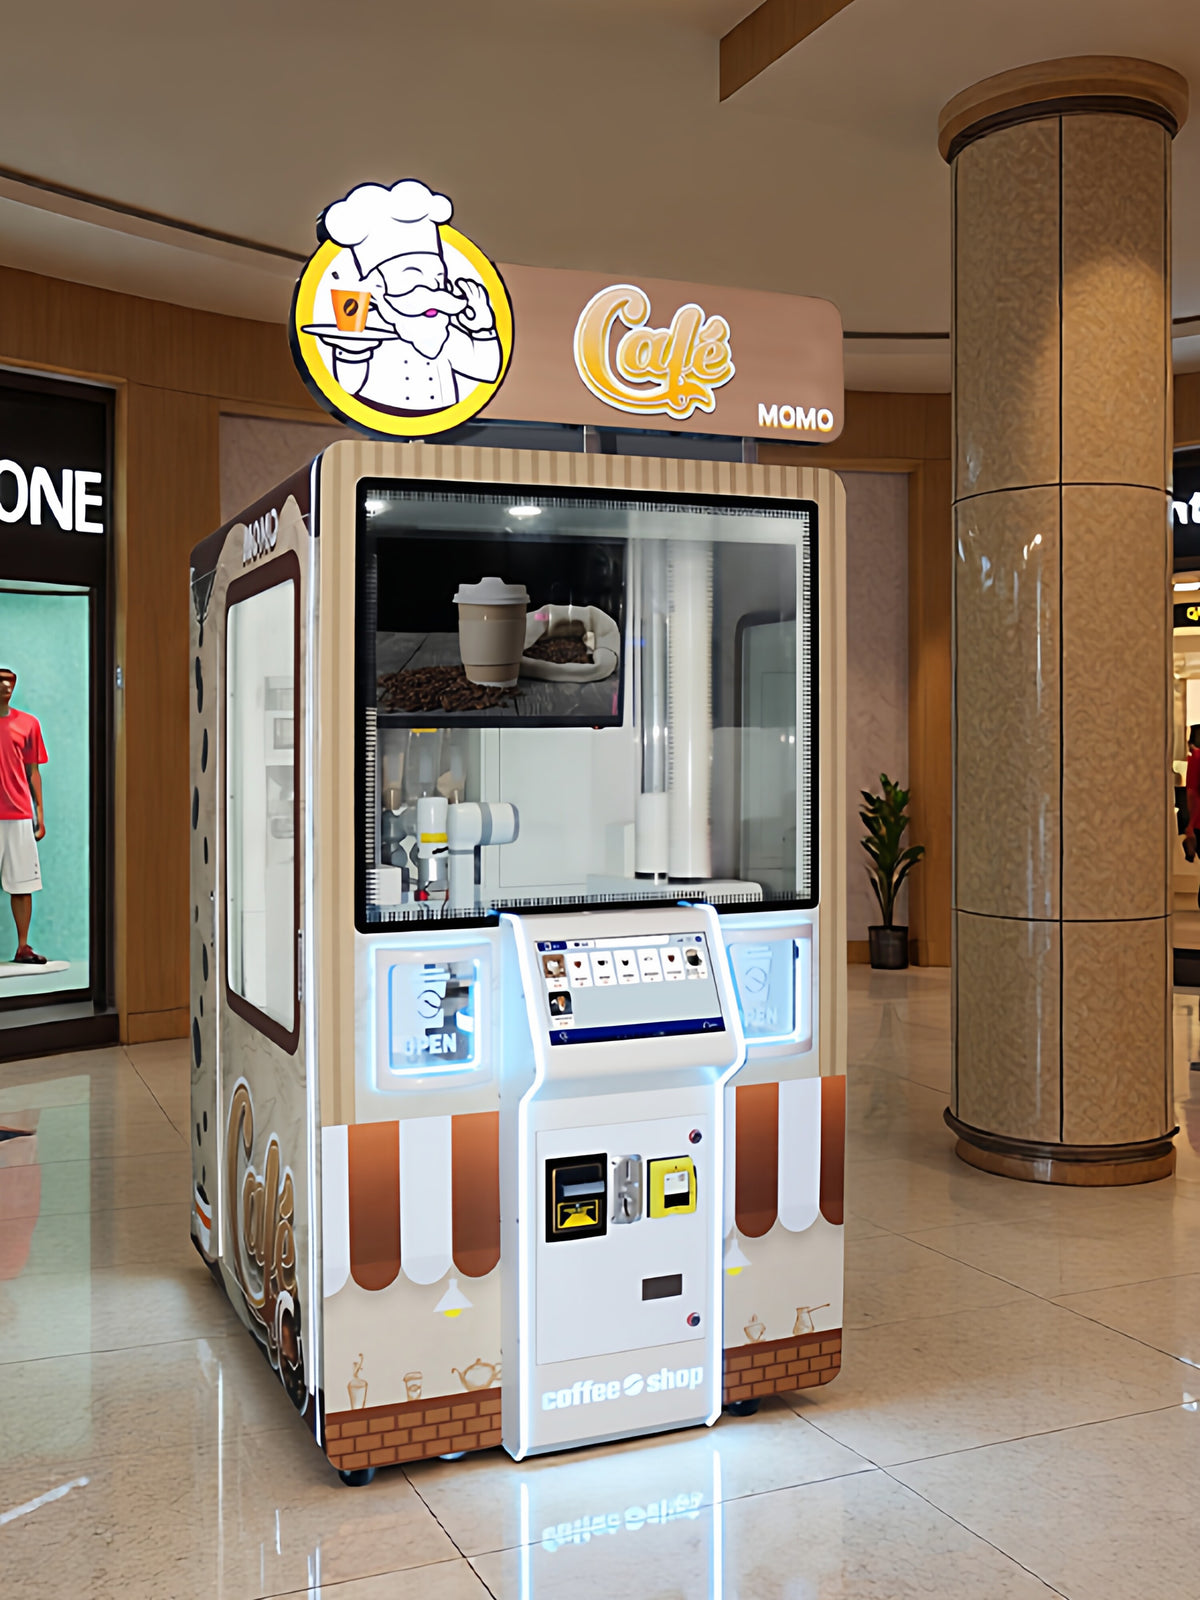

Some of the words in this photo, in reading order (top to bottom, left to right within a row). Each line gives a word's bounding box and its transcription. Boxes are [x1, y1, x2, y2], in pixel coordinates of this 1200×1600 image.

[574, 284, 736, 420] Café
[758, 403, 833, 432] MOMO
[0, 459, 104, 534] ONE
[404, 1032, 457, 1056] OPEN
[541, 1379, 621, 1411] coffee
[646, 1366, 704, 1393] shop
